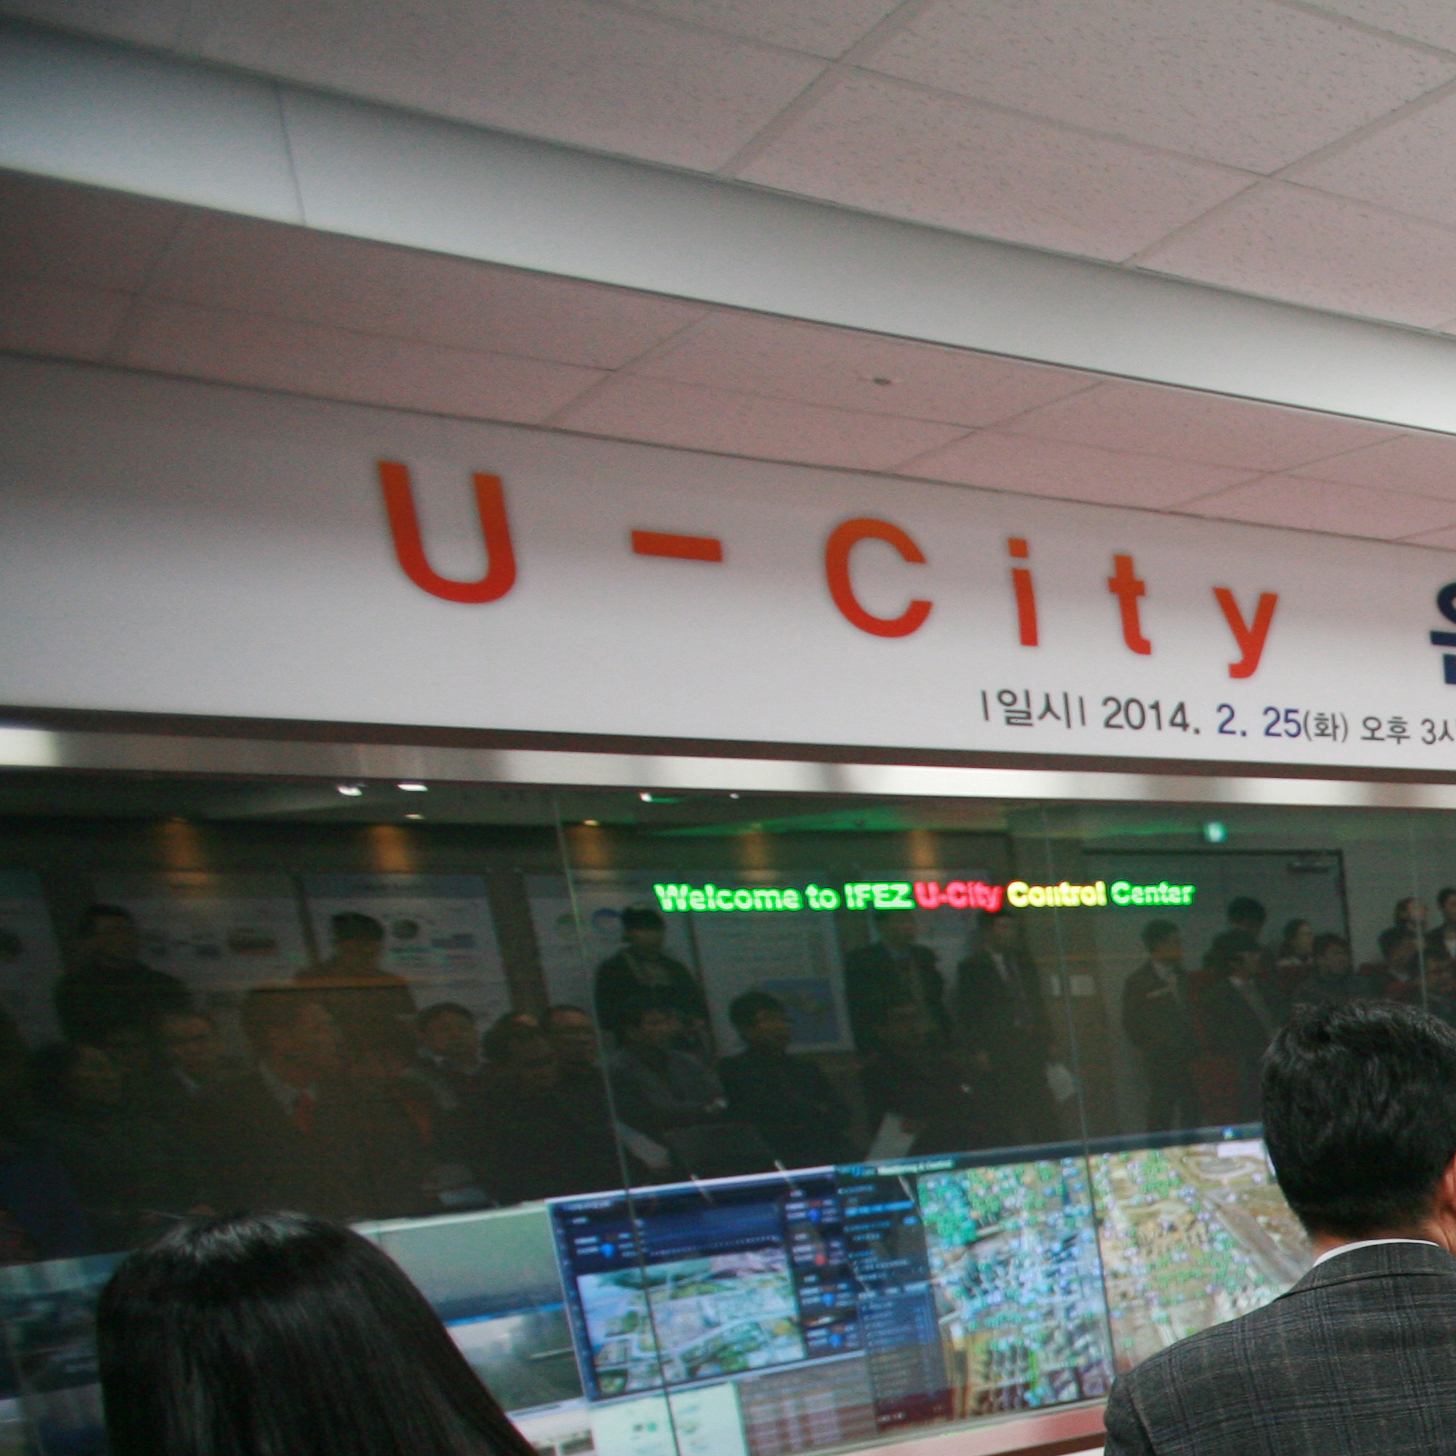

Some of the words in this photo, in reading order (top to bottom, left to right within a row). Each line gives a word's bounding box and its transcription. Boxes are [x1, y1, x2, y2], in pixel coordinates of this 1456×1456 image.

[1101, 696, 1200, 735] 2014.
[1216, 703, 1247, 737] 2.
[1263, 706, 1348, 742] 25(화)
[1361, 716, 1410, 745] 오후
[653, 883, 803, 912] Welcome
[804, 883, 841, 911] to
[843, 882, 915, 910] IFEZ
[913, 880, 1004, 913] U-City
[1006, 880, 1107, 907] Control
[1110, 880, 1196, 906] Center
